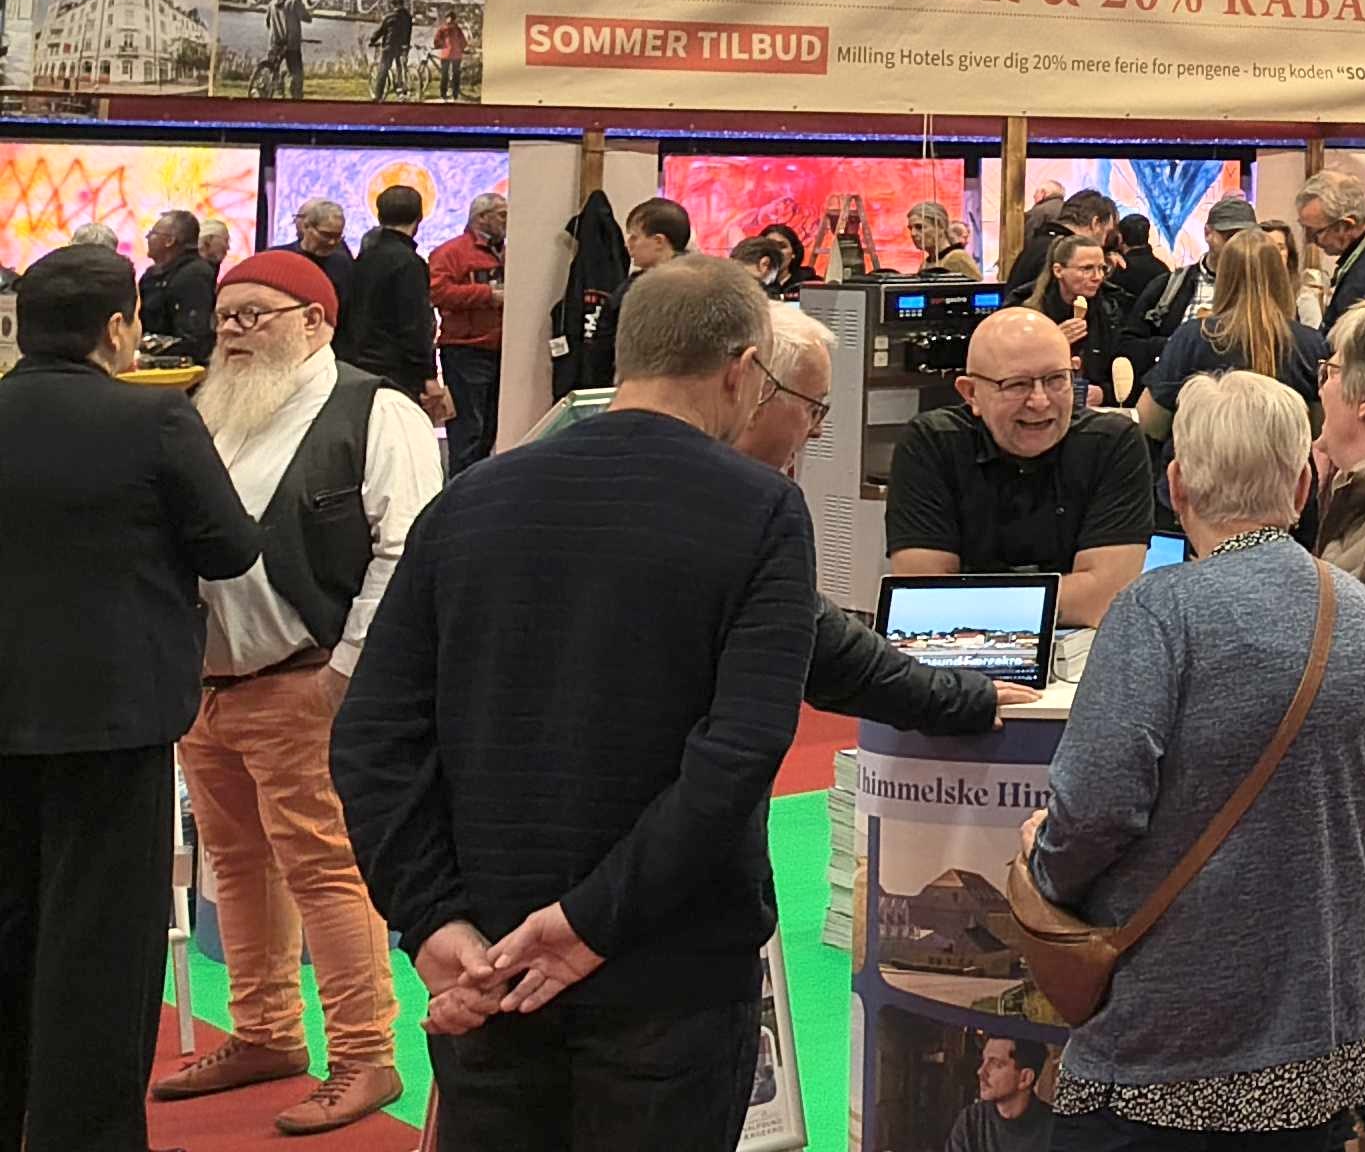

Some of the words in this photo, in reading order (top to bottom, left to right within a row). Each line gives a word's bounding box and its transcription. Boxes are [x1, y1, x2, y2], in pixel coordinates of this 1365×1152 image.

[528, 23, 688, 59] SOMMER
[697, 31, 822, 62] TILBUD
[837, 44, 895, 70] Milling
[900, 47, 954, 70] Hotels
[958, 50, 1000, 73] giver
[1003, 52, 1029, 75] dig
[1032, 54, 1067, 72] 20%
[1071, 57, 1111, 74] mere
[1114, 55, 1148, 75] ferie
[1152, 56, 1173, 75] for
[1176, 61, 1241, 81] pengene
[1252, 62, 1287, 83] brug
[1290, 62, 1334, 81] koden
[863, 766, 989, 807] himmelske
